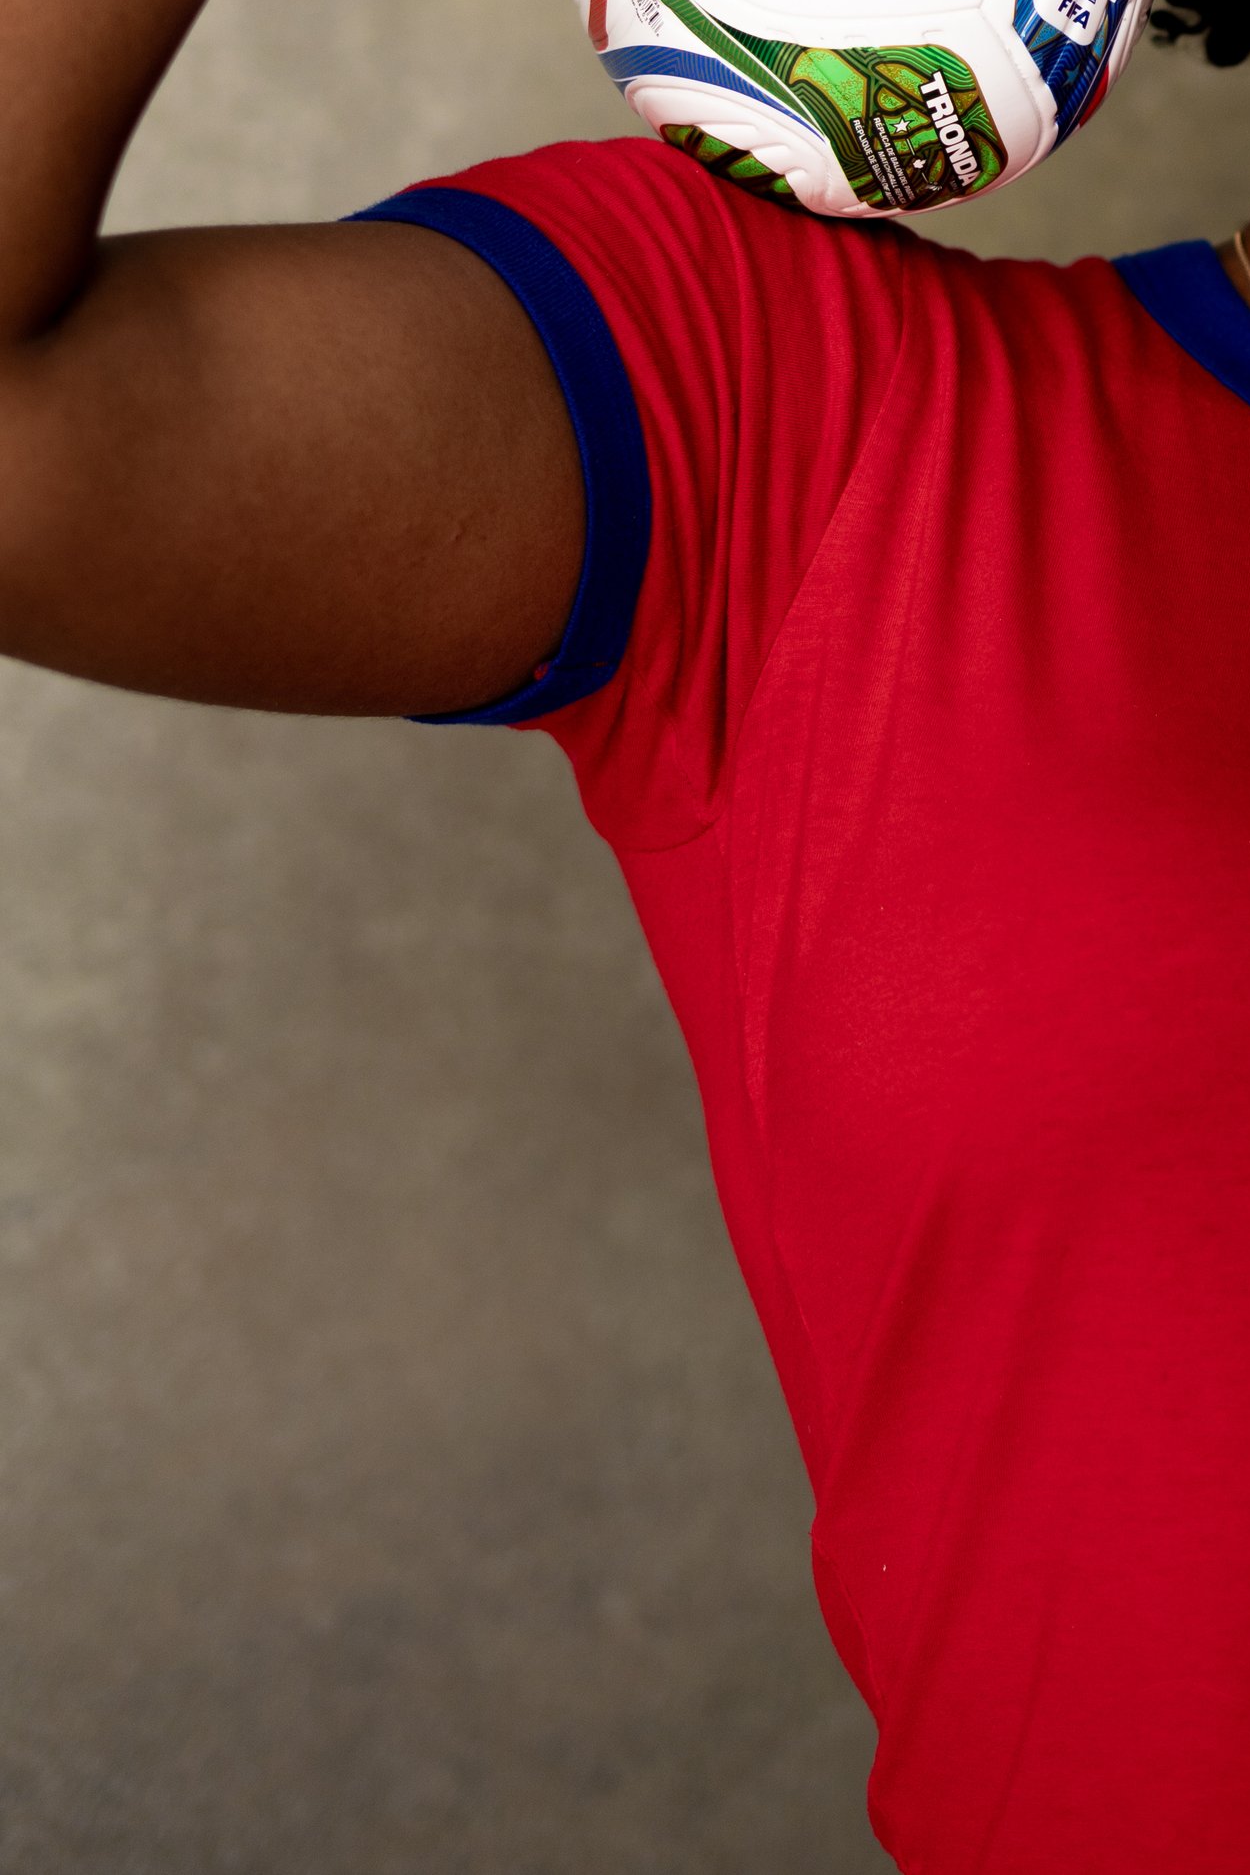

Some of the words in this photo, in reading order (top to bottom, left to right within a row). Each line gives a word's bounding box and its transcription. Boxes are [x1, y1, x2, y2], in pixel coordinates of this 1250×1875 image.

[853, 119, 873, 158] RÉPLIQUE
[868, 154, 877, 165] DE
[873, 117, 891, 147] RÉPLICA
[886, 147, 895, 156] DE
[920, 71, 981, 187] TRIONDA
